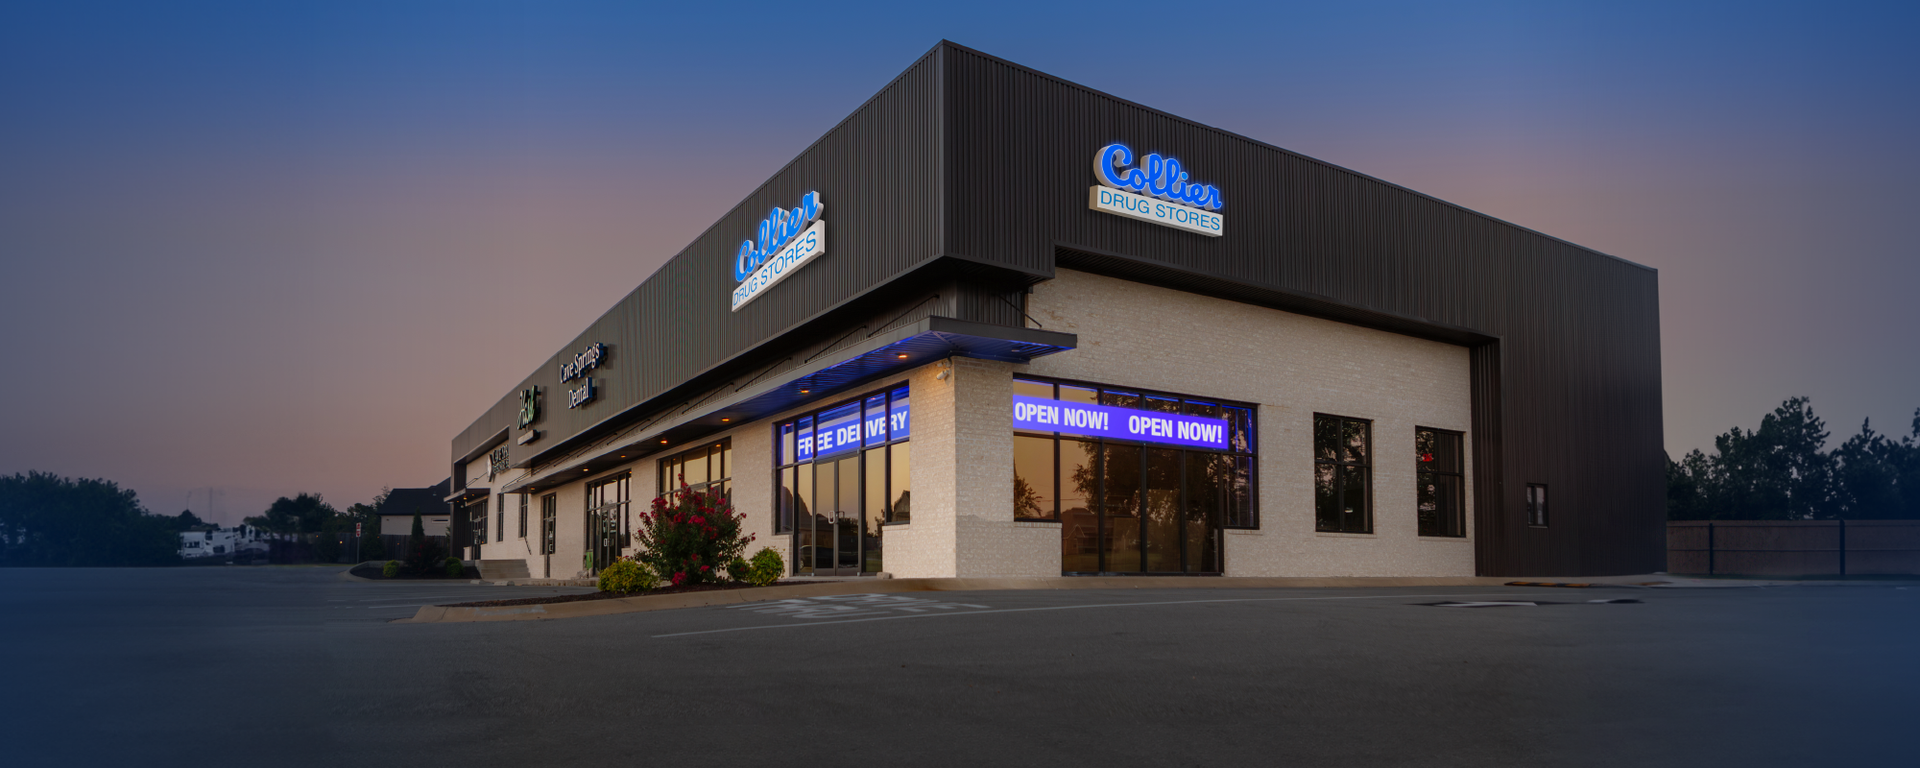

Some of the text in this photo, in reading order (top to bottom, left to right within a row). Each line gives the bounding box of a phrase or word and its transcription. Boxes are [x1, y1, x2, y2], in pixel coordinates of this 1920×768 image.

[1099, 143, 1222, 210] Collier
[1100, 190, 1221, 231] DRUG STORES
[735, 191, 820, 282] Collier
[733, 230, 817, 306] DRUG STORES
[560, 341, 600, 384] Cave Springs
[568, 377, 589, 409] Dental
[798, 411, 908, 457] FREE DELIVERY
[1014, 402, 1223, 443] OPEN NOW! OPEN NOW!
